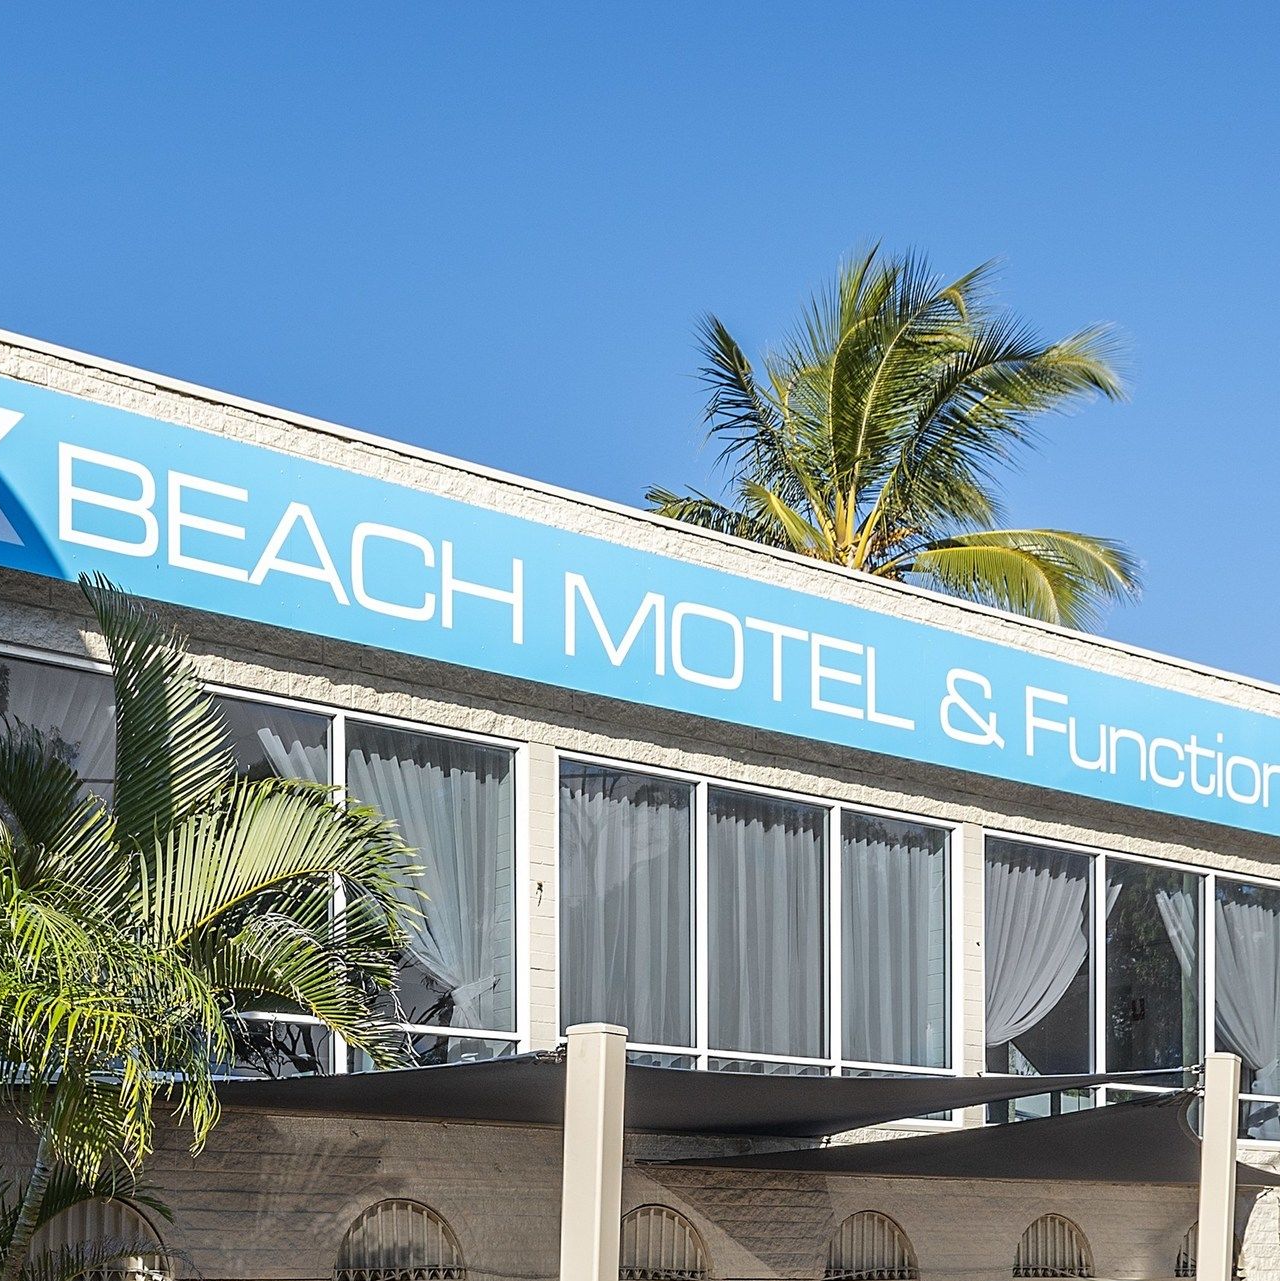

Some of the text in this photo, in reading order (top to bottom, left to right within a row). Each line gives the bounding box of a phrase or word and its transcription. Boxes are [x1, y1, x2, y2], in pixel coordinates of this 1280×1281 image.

[58, 441, 524, 646] BEACH
[564, 570, 916, 731] MOTEL
[939, 667, 1006, 750] &
